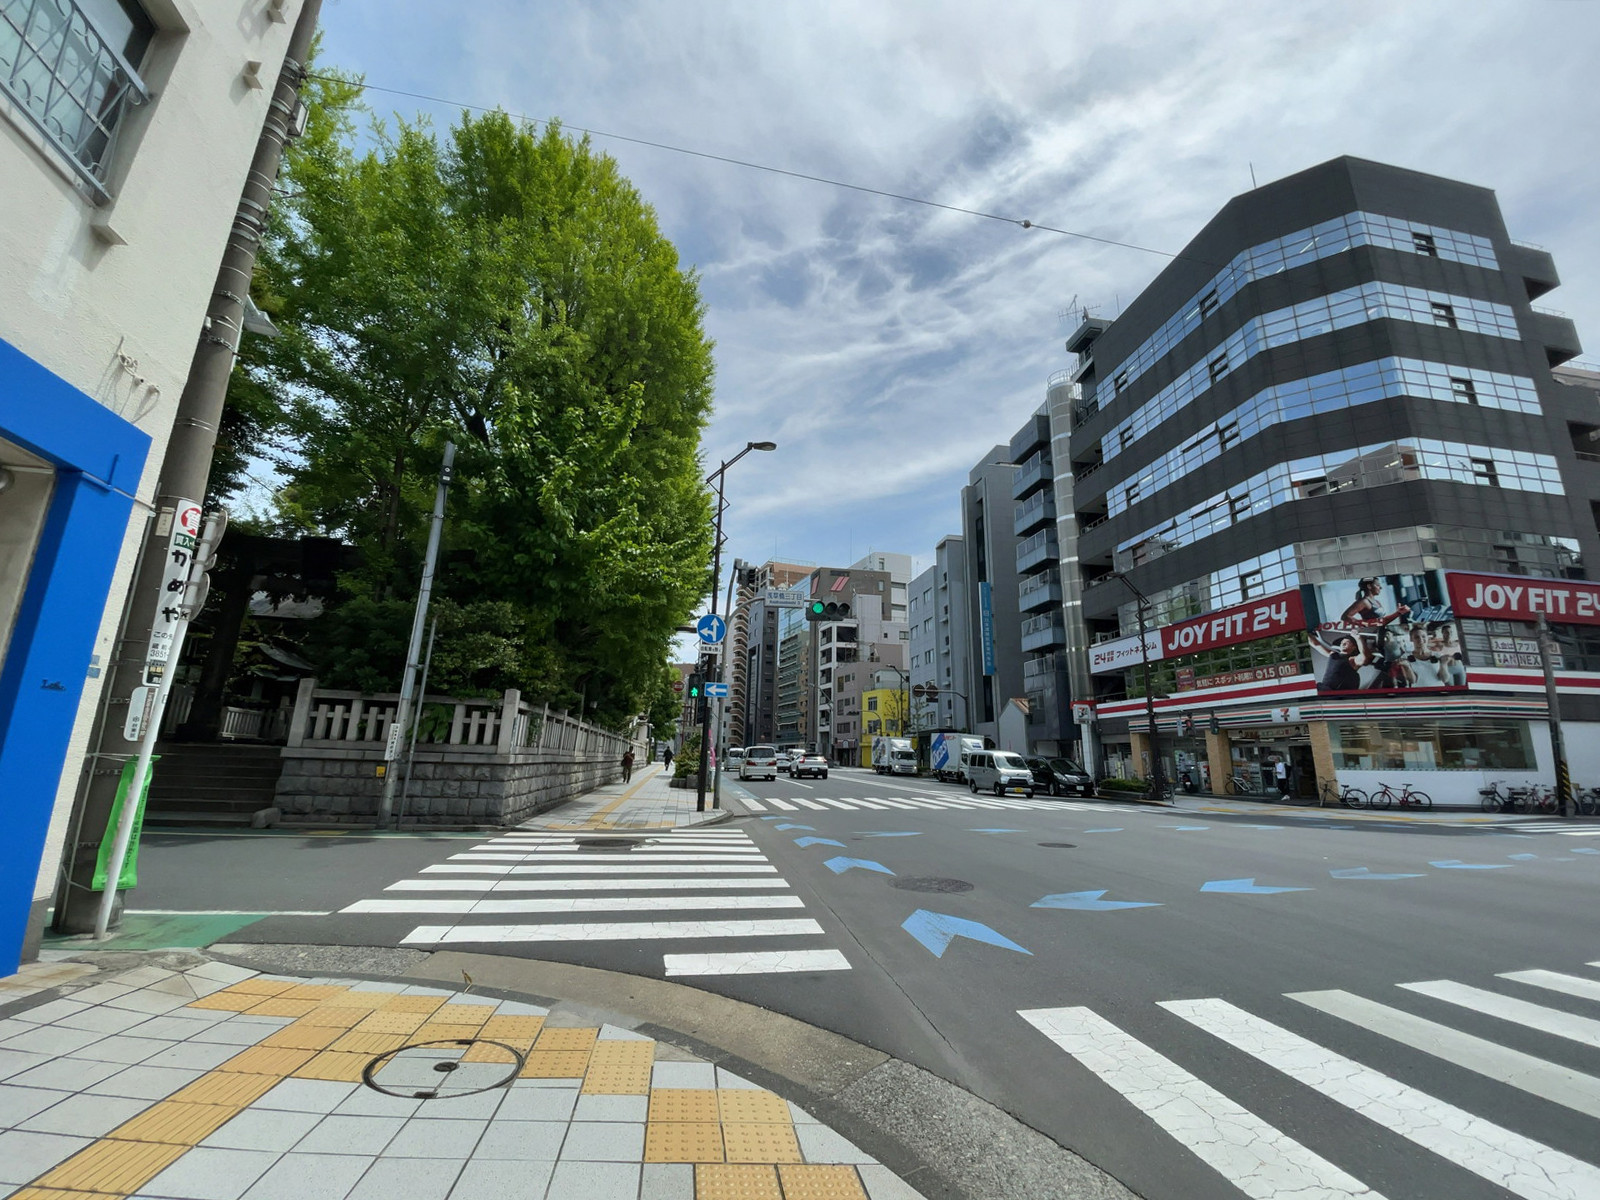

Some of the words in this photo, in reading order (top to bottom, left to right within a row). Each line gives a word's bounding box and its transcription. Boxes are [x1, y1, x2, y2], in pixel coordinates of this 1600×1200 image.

[767, 592, 803, 600] 浅草橋三丁目
[1466, 584, 1523, 611] JOY
[1528, 588, 1570, 615] FIT
[1168, 622, 1208, 651] JOY
[1211, 612, 1248, 641] FIT
[1253, 601, 1288, 631] 24
